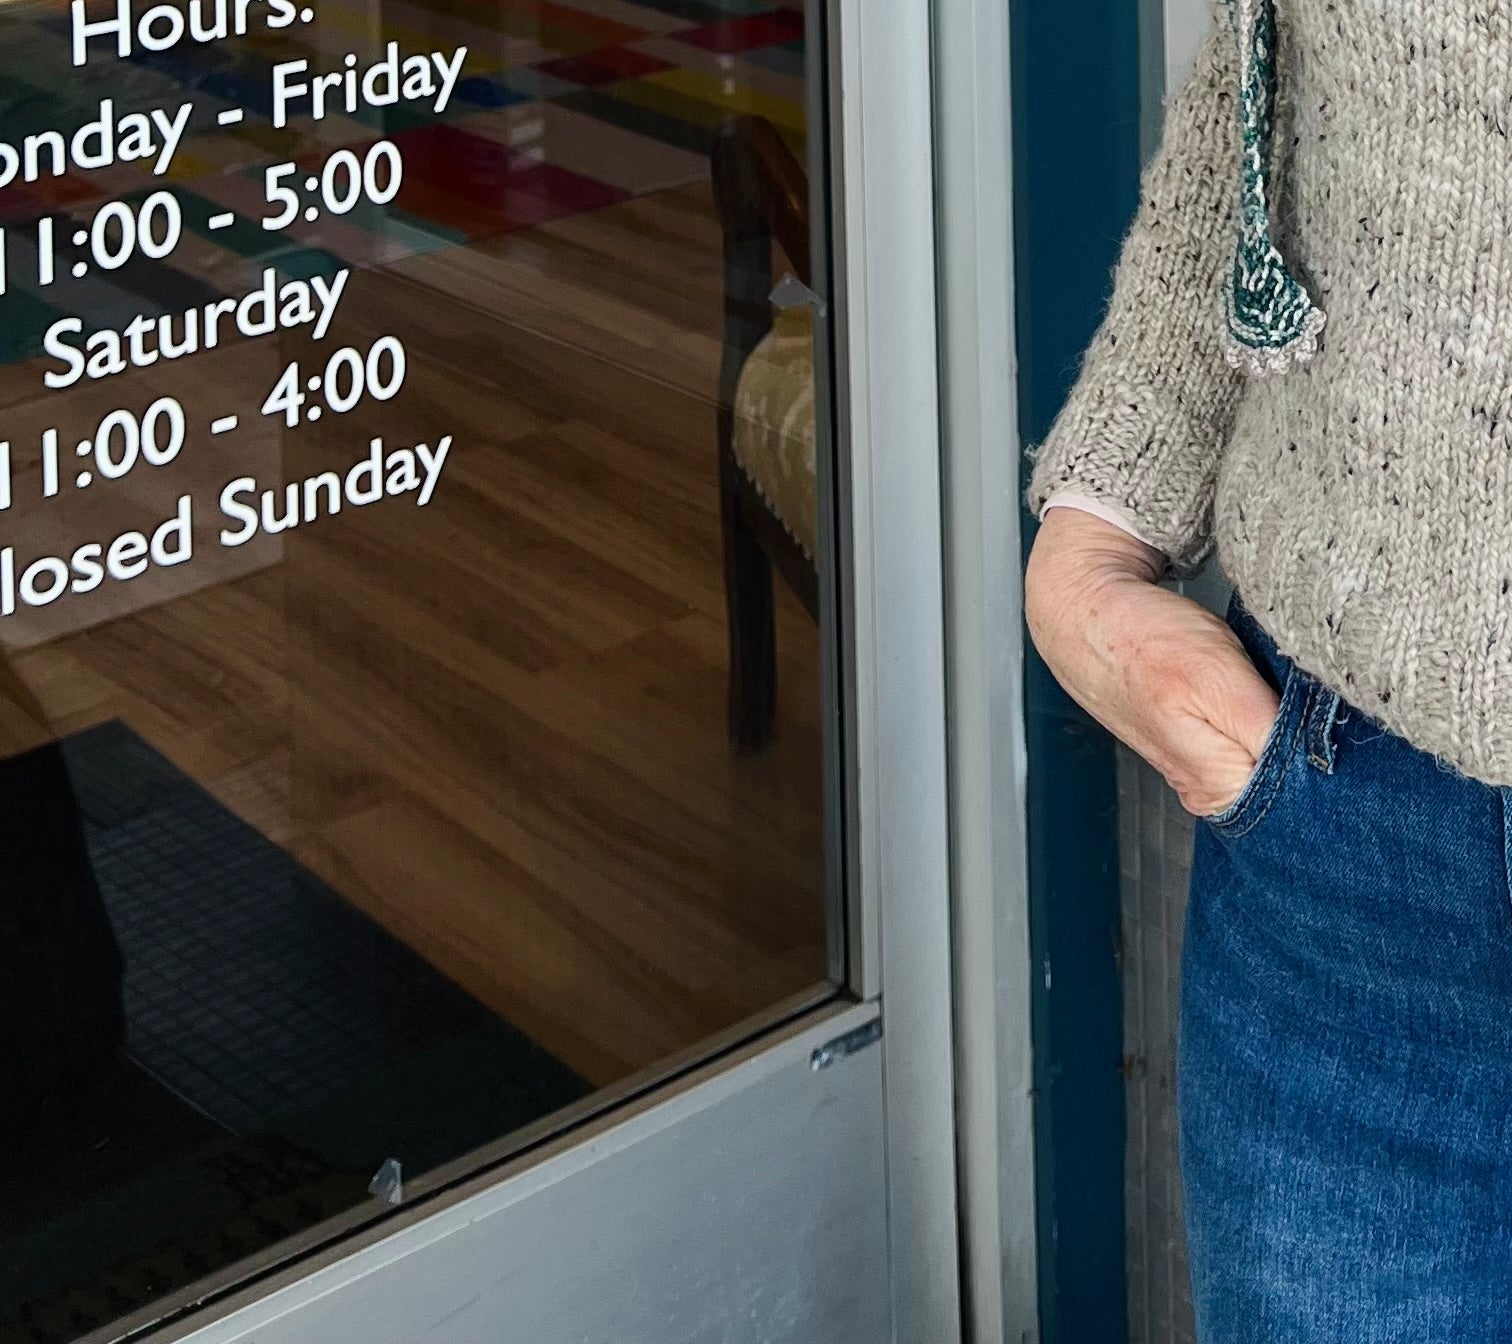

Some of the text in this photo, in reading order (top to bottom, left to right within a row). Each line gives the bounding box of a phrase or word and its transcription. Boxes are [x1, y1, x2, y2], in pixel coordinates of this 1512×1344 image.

[272, 40, 469, 130] Friday
[261, 139, 404, 232] 5:00
[42, 267, 350, 389] Saturday
[260, 335, 406, 429] 4:00
[0, 435, 453, 617] losed Sunday
